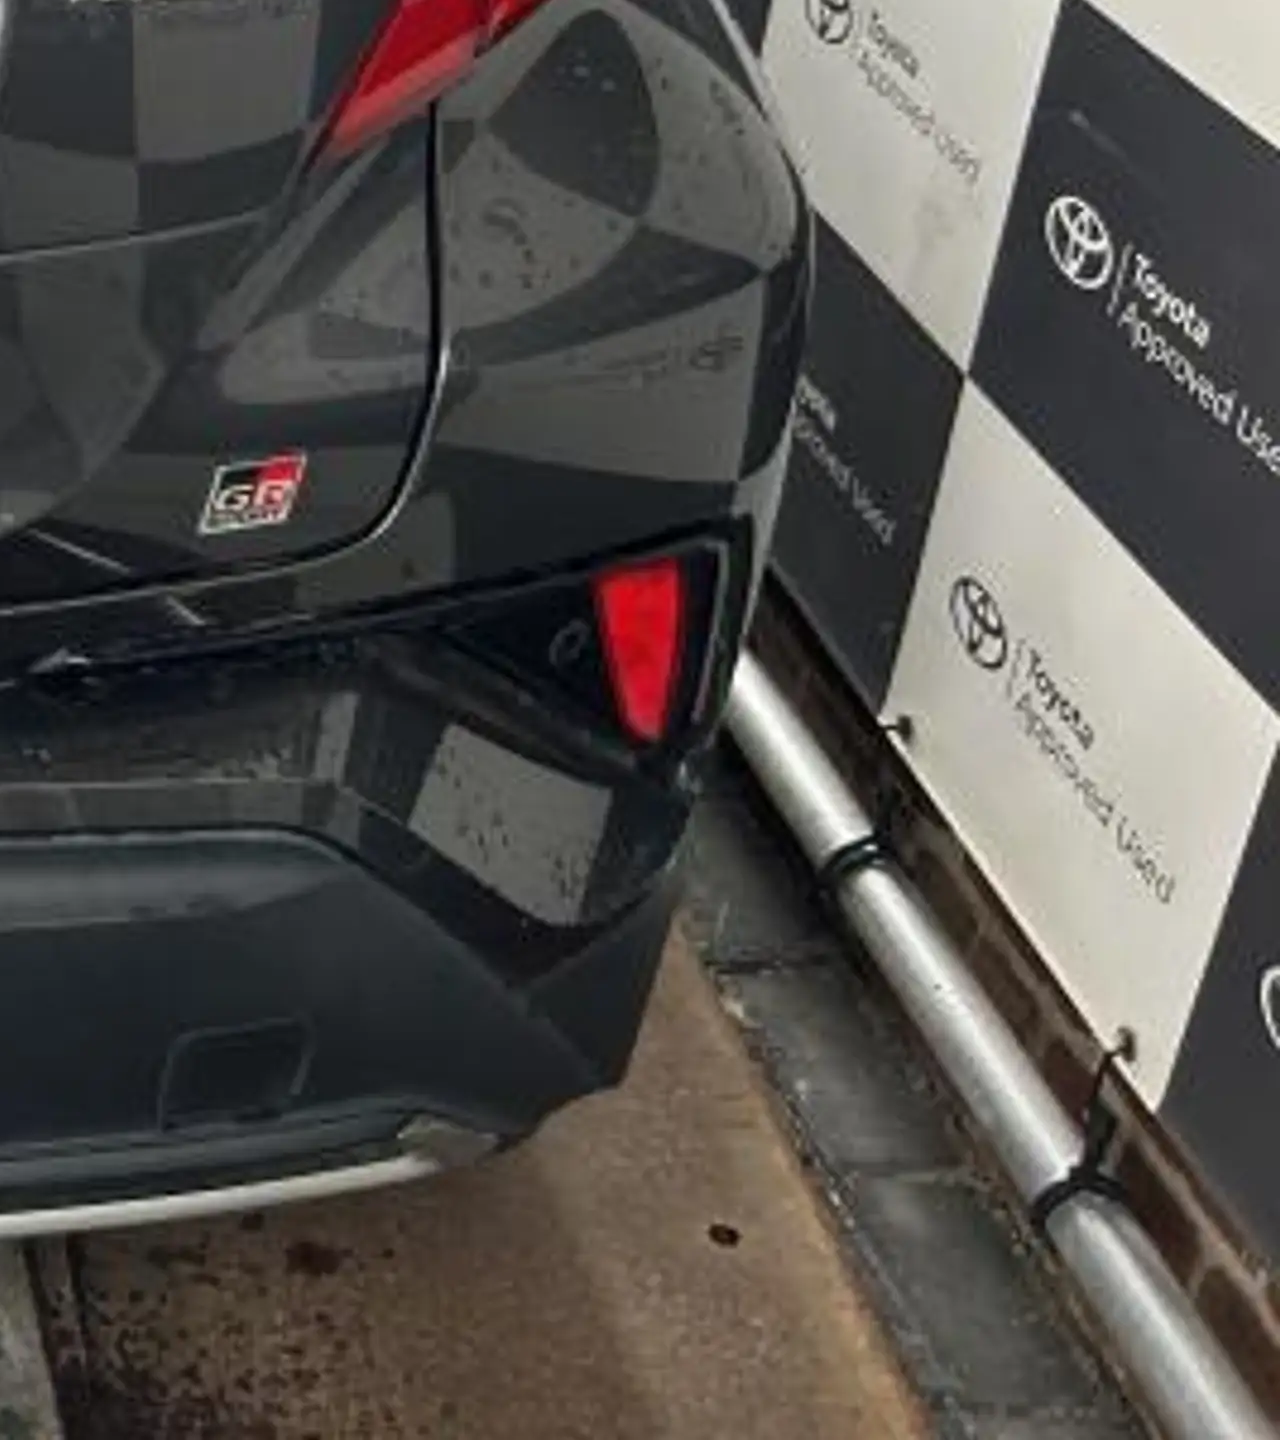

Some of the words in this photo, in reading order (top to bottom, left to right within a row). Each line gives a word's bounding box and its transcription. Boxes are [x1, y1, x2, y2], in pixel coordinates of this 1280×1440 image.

[1133, 252, 1209, 349] Toyota
[1116, 301, 1238, 426] Approved
[1025, 647, 1095, 751] Toyota
[1014, 690, 1122, 828] Approved
[1115, 813, 1176, 905] Used
